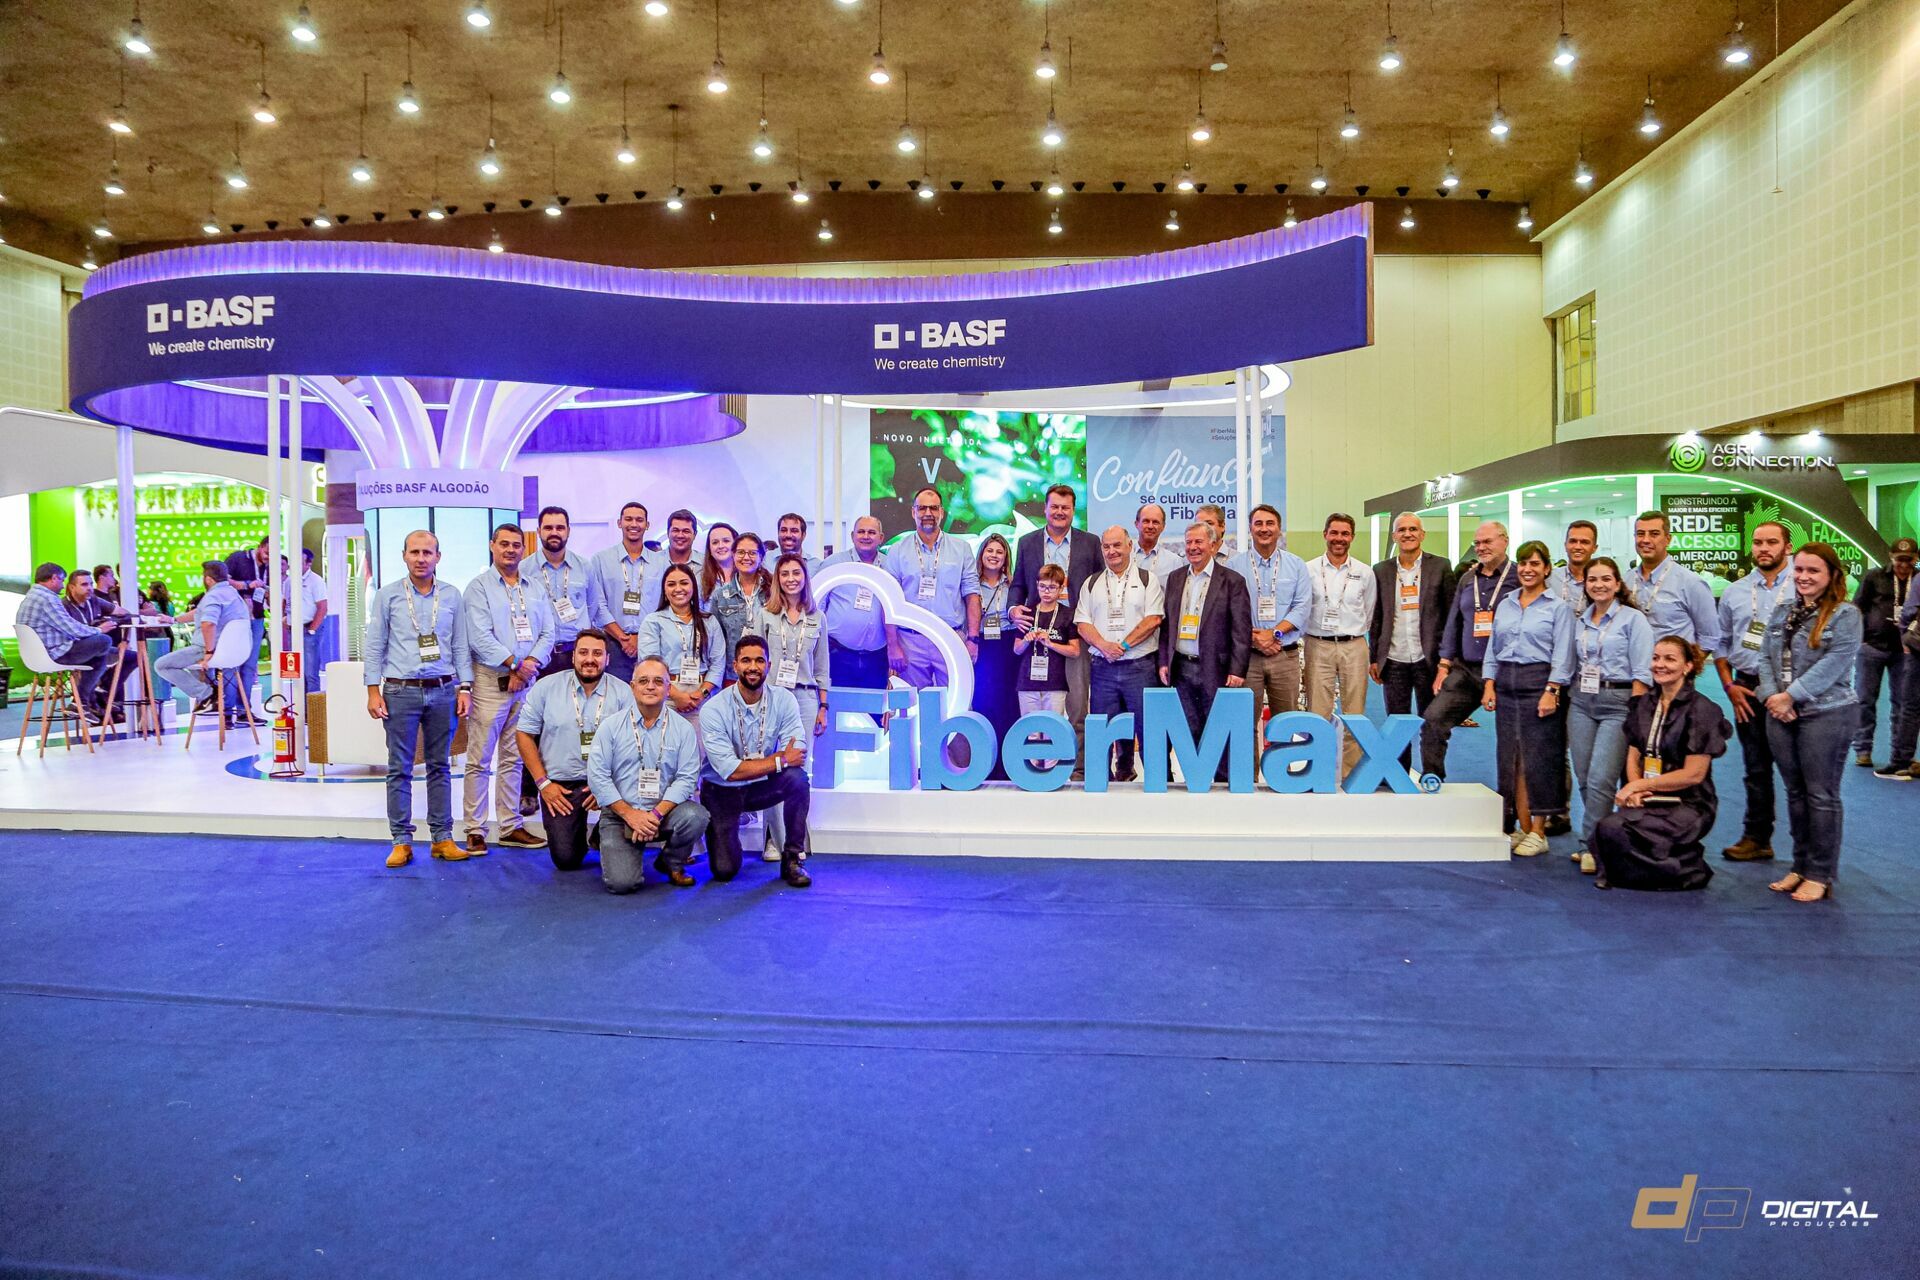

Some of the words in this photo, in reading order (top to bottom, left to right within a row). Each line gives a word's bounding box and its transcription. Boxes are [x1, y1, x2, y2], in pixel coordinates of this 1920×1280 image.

[186, 295, 275, 329] BASF
[921, 319, 1006, 348] BASF
[148, 342, 166, 356] We
[168, 339, 205, 354] create
[208, 335, 275, 352] chemistry
[874, 357, 896, 370] We
[898, 357, 939, 369] create
[942, 354, 1006, 368] chemistry
[883, 433, 913, 443] NOVO
[919, 435, 982, 446] INSETIDA
[395, 482, 427, 494] BASF
[430, 481, 489, 494] ALGODÃO
[1140, 495, 1156, 504] se
[1159, 492, 1204, 504] cultiva
[1208, 494, 1238, 504] com
[1668, 497, 1729, 506] CONSTRUINDO
[1731, 497, 1738, 505] A
[1668, 514, 1723, 532] REDE
[1725, 523, 1738, 532] DE
[1668, 534, 1738, 549] ACESSO
[1680, 551, 1738, 561] MERCADO
